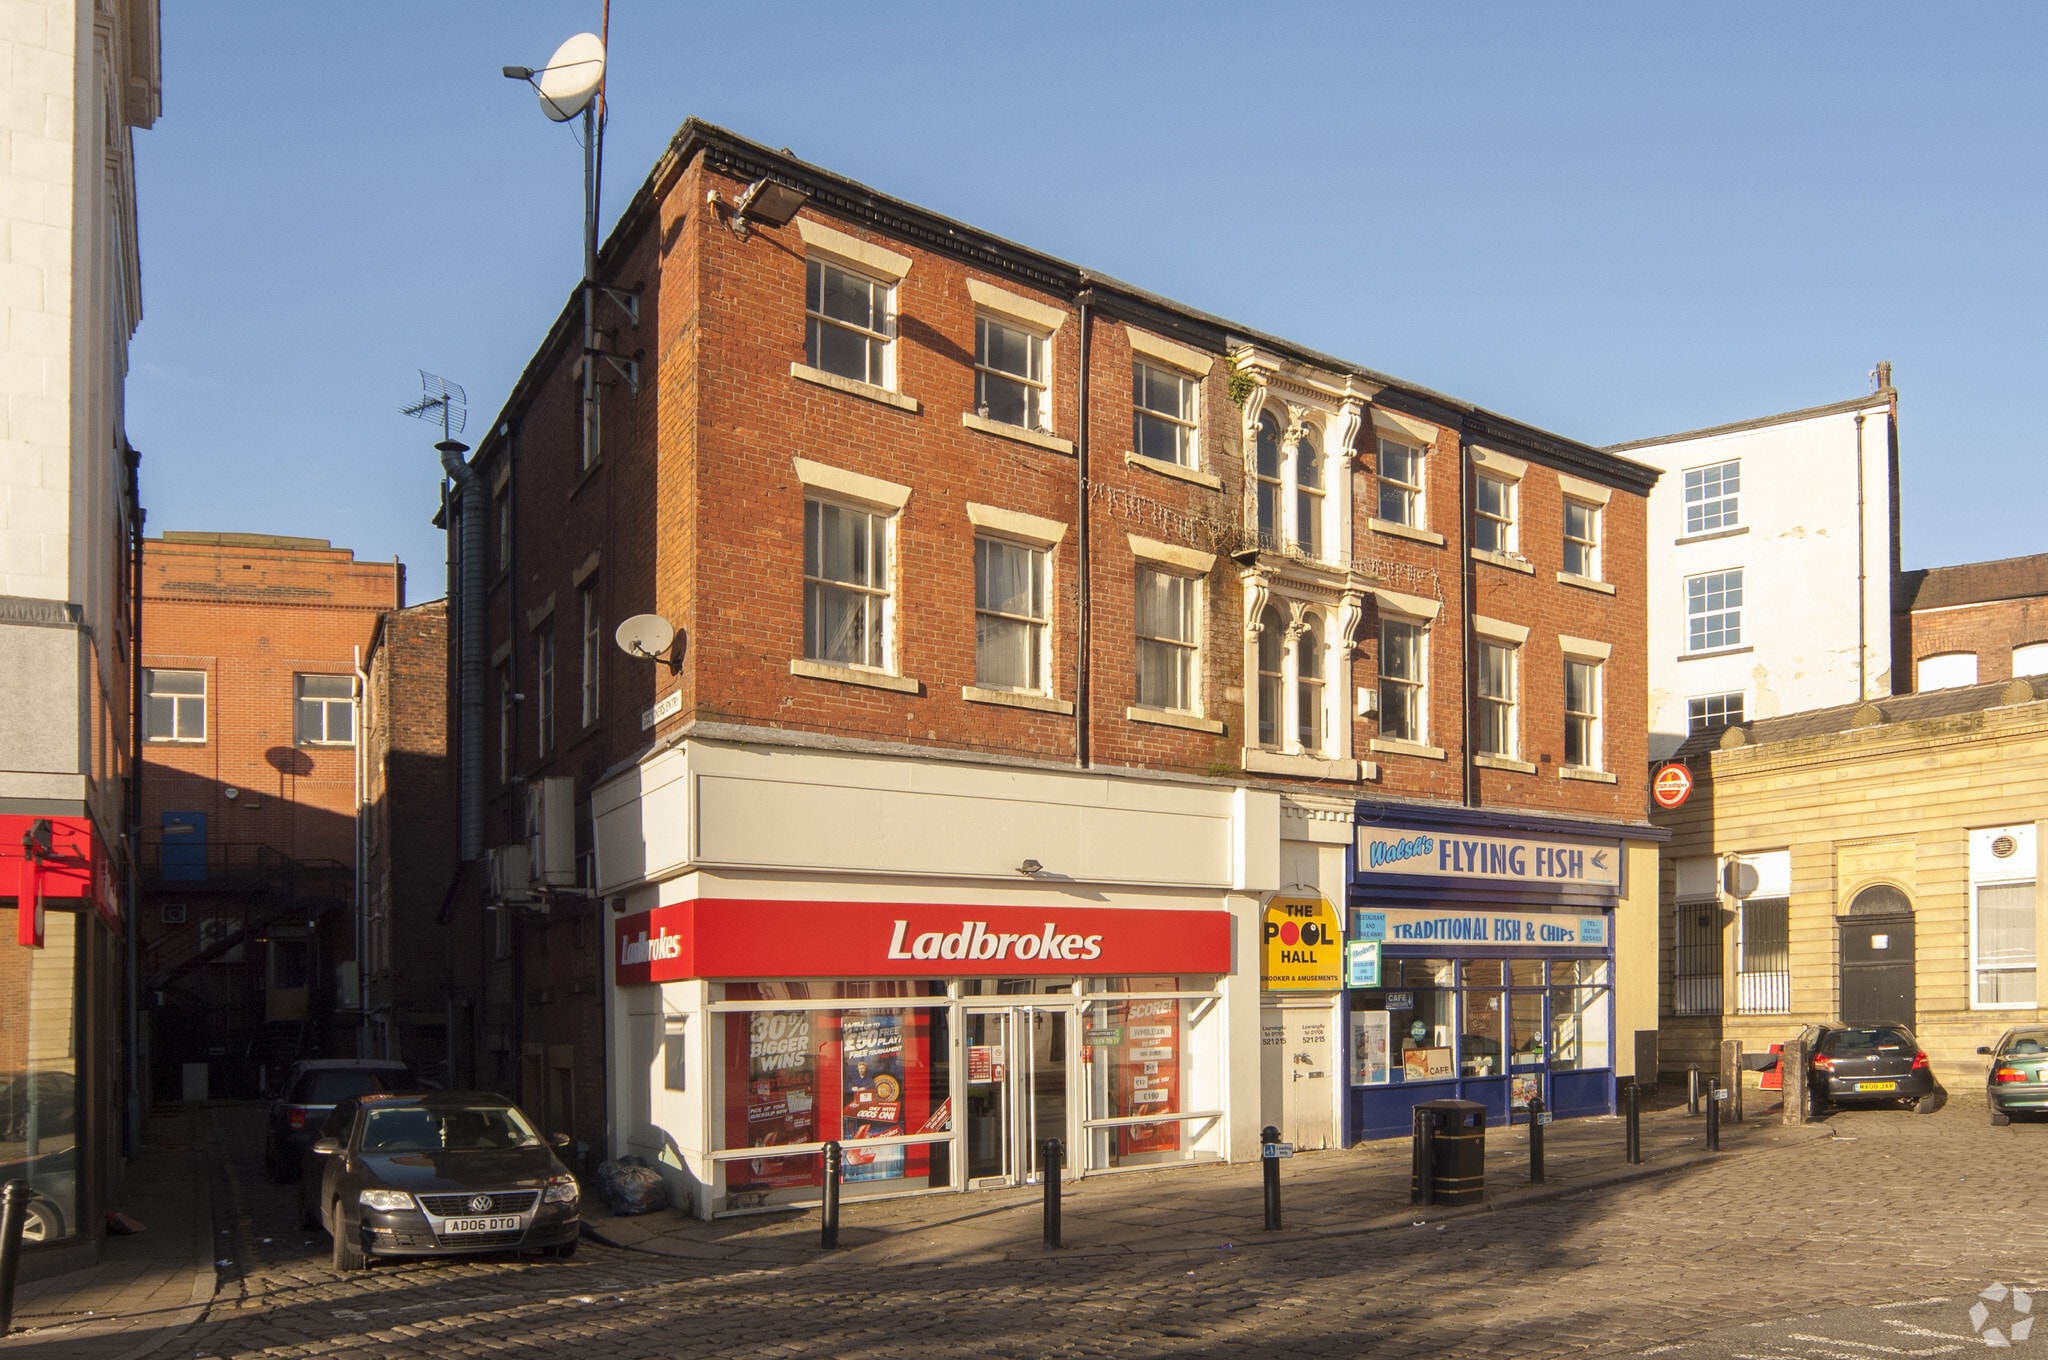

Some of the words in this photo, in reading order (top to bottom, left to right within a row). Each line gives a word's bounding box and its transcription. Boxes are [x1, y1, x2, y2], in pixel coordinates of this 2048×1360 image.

[1369, 835, 1434, 868] Walsh's
[1439, 839, 1526, 876] FLYING
[1536, 846, 1583, 879] FISH
[1286, 904, 1313, 917] THE
[887, 919, 1103, 960] Ladbrokes
[1264, 921, 1334, 946] POOL
[1392, 917, 1489, 940] TRADITIONAL
[1494, 918, 1521, 941] FISH
[1525, 921, 1535, 941] &
[1540, 924, 1575, 942] CHIPS
[621, 927, 682, 966] Ladbrokes
[1281, 950, 1317, 963] HALL
[1388, 994, 1407, 1002] CAFE
[1128, 1000, 1173, 1020] SCORE!
[751, 1013, 809, 1042] 30%
[879, 1026, 902, 1036] FREE
[1134, 1028, 1165, 1037] WIMBLEDON
[750, 1036, 809, 1058] BIGGER
[843, 1030, 879, 1052] £50
[877, 1035, 902, 1046] PLAY!
[761, 1051, 806, 1072] WINS
[849, 1049, 868, 1059] FREE
[1429, 1066, 1449, 1075] CAFE
[452, 1219, 486, 1232] AD06
[489, 1218, 514, 1229] DTO
